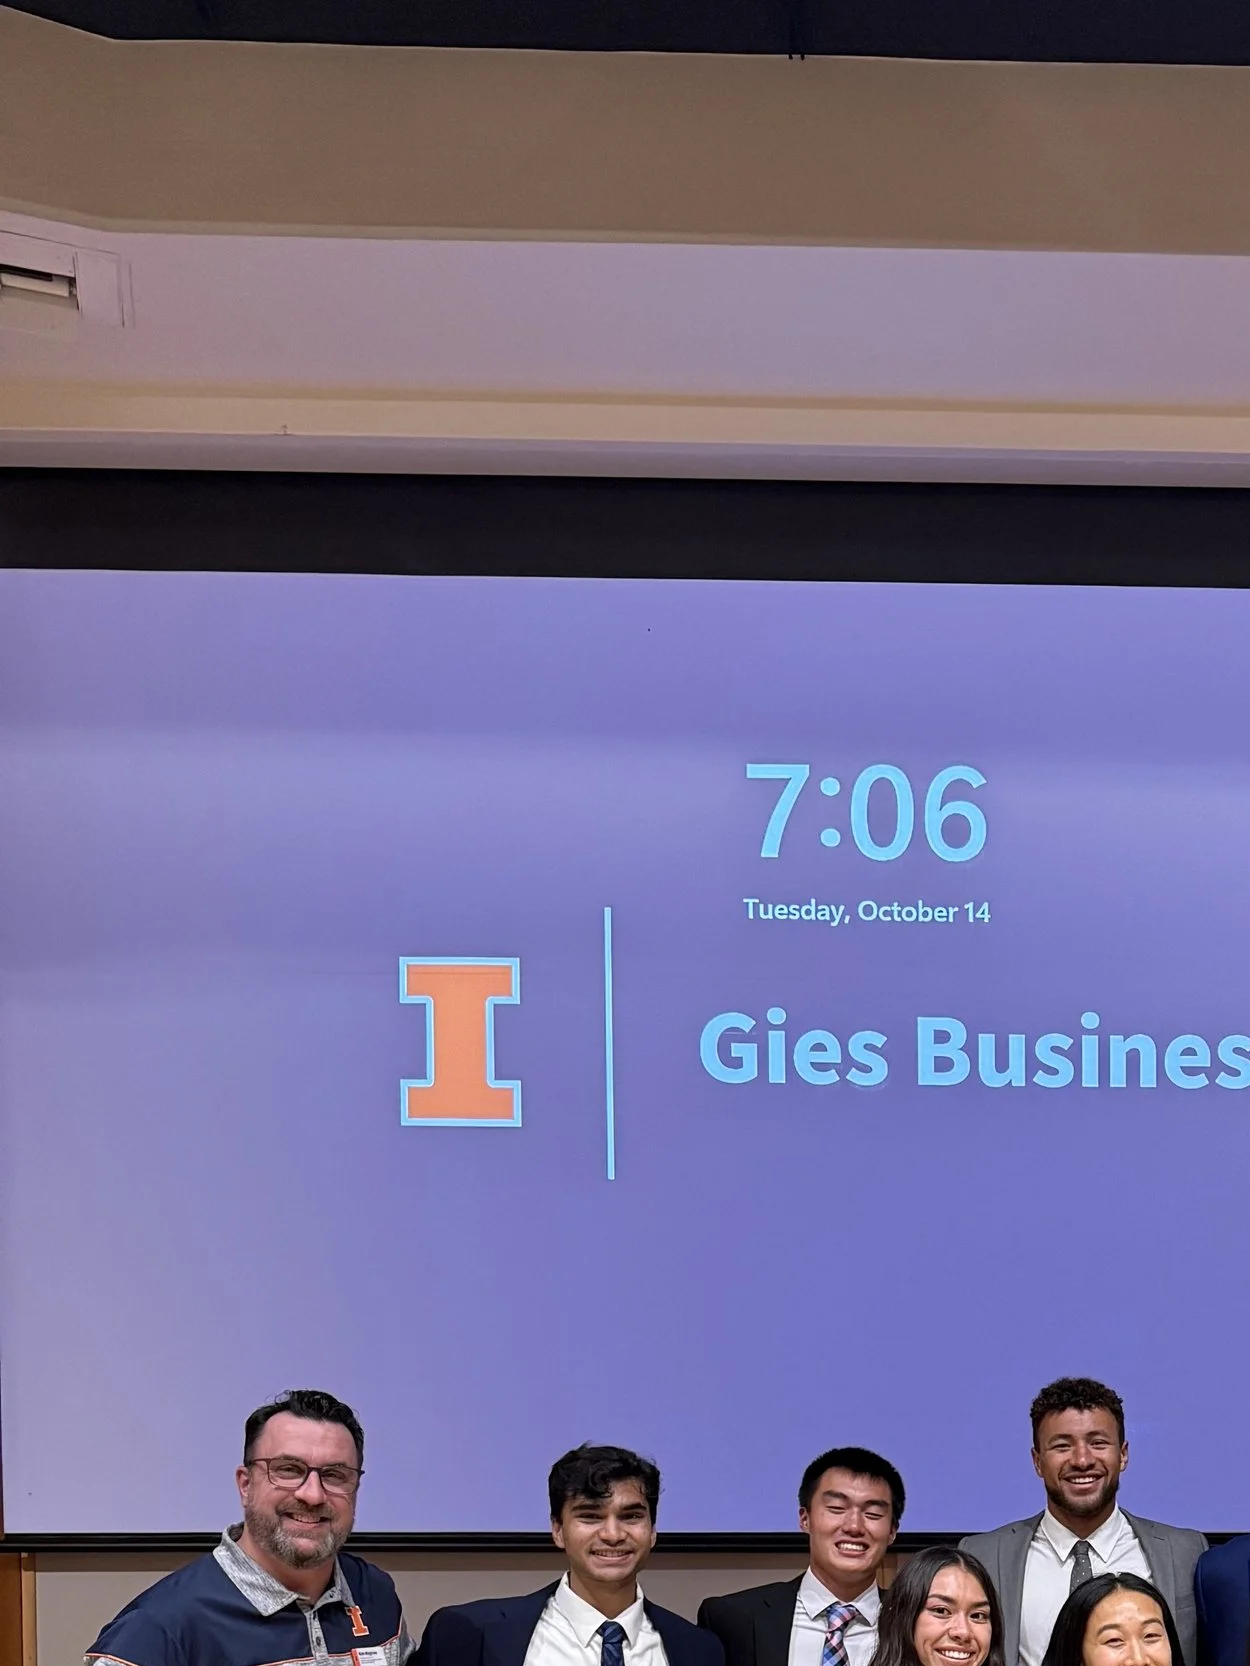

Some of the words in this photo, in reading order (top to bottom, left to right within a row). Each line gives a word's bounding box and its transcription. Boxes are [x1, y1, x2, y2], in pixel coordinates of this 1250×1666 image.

[746, 763, 987, 862] 7:06
[743, 898, 851, 926] Tuesday,
[857, 899, 959, 923] October
[964, 901, 991, 923] 14
[399, 956, 522, 1127] I
[699, 1008, 889, 1086] Gies
[344, 1605, 370, 1637] I
